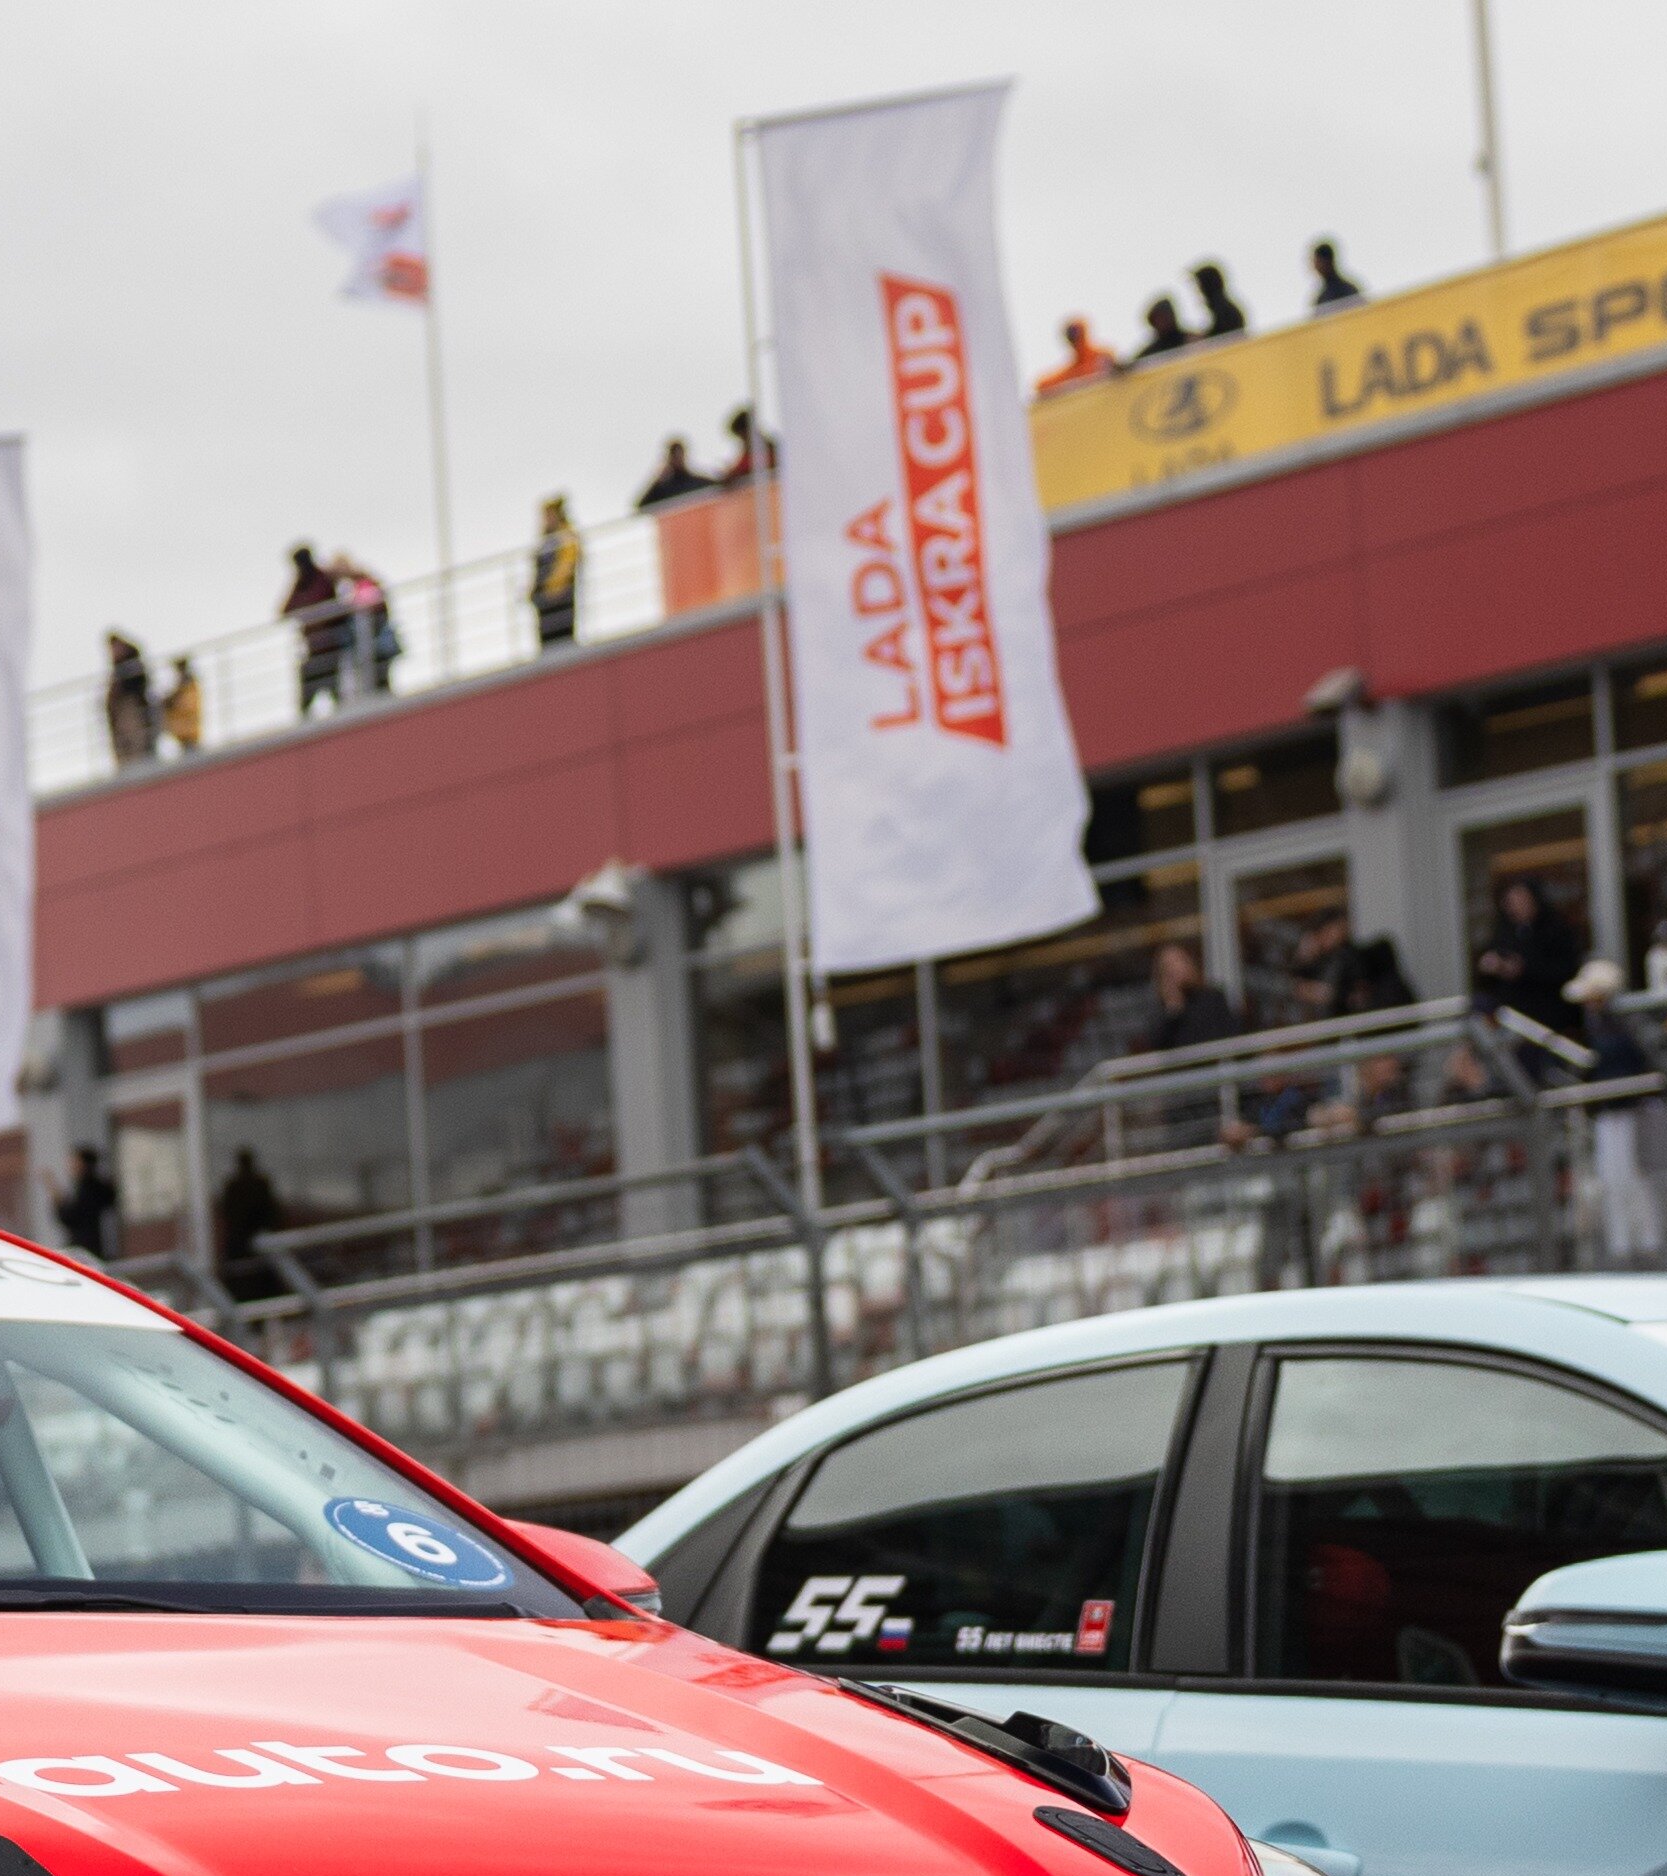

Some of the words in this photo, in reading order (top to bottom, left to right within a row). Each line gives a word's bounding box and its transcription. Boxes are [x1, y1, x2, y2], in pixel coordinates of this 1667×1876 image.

[892, 290, 970, 468] CUP
[1319, 320, 1491, 420] LADA
[846, 500, 921, 731] LADA
[913, 469, 996, 724] ISKRA
[386, 1522, 458, 1565] 6
[766, 1575, 907, 1654] 55
